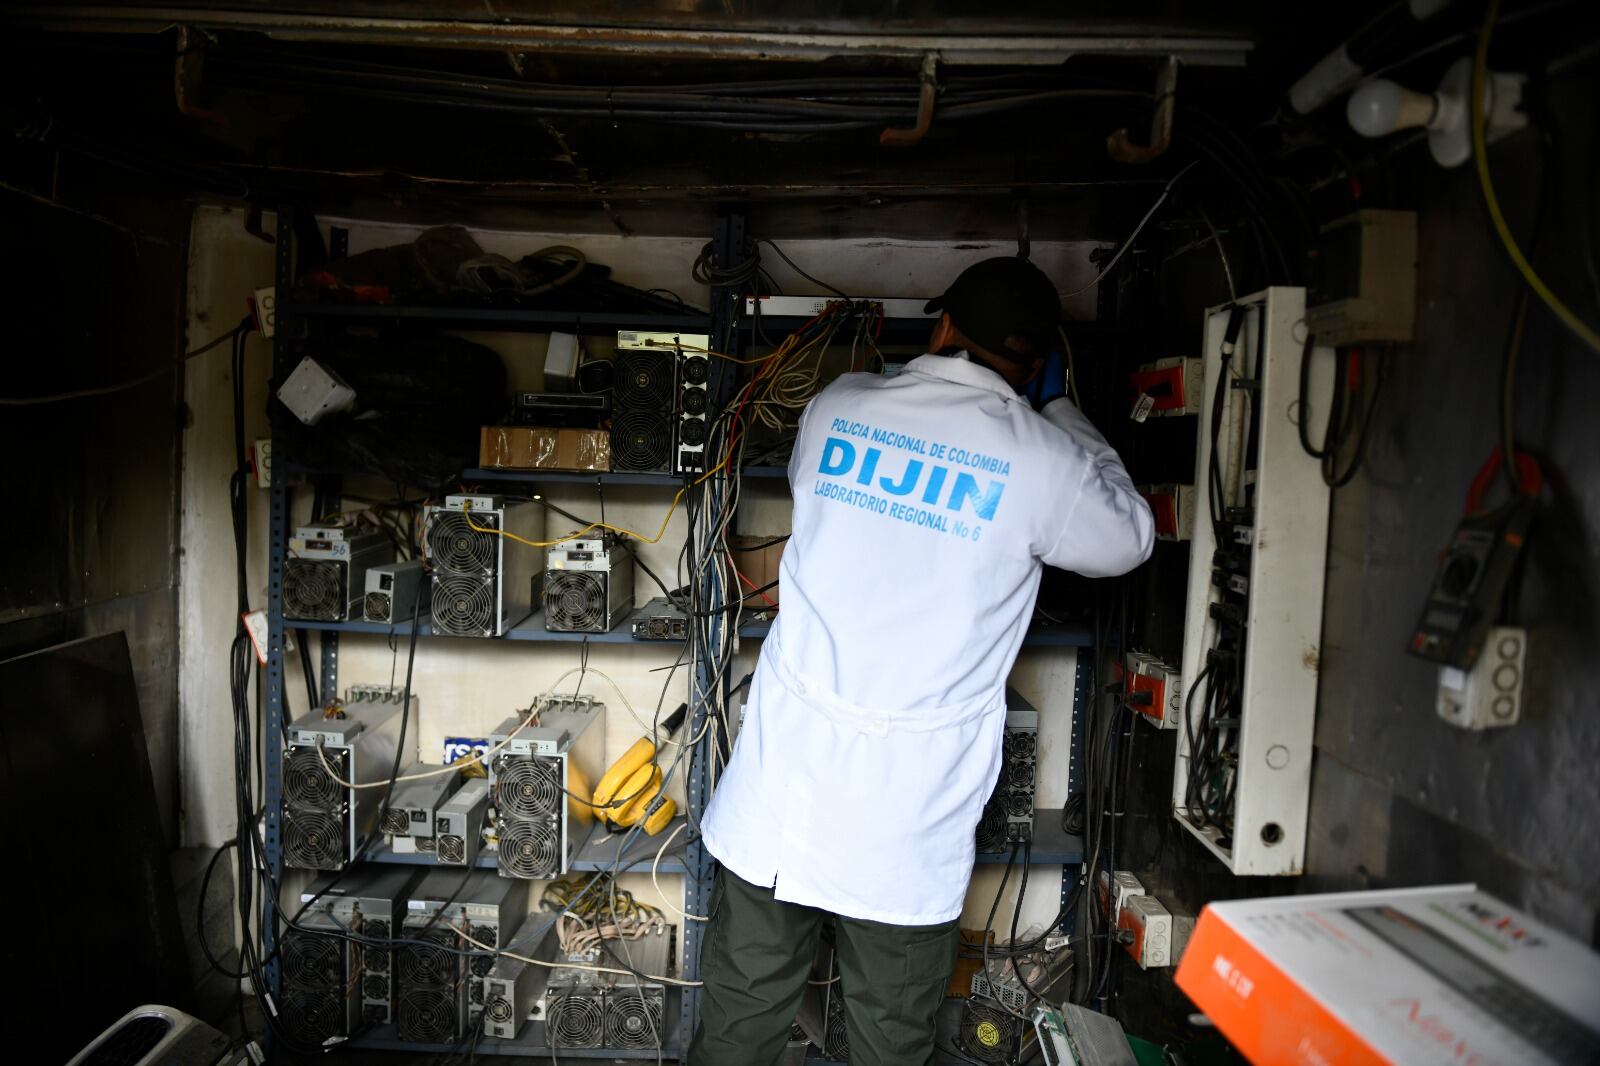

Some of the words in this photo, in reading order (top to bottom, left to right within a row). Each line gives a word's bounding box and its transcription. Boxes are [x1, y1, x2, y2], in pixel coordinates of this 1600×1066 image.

[831, 416, 870, 440] POLICIA
[871, 427, 926, 455] NACIONAL
[929, 442, 945, 459] DE
[949, 447, 1011, 477] COLOMBIA
[814, 479, 887, 514] LABORATORIO
[888, 502, 949, 533] REGIONAL
[951, 520, 969, 539] No
[971, 525, 982, 542] 6
[818, 436, 1006, 522] DIJIN
